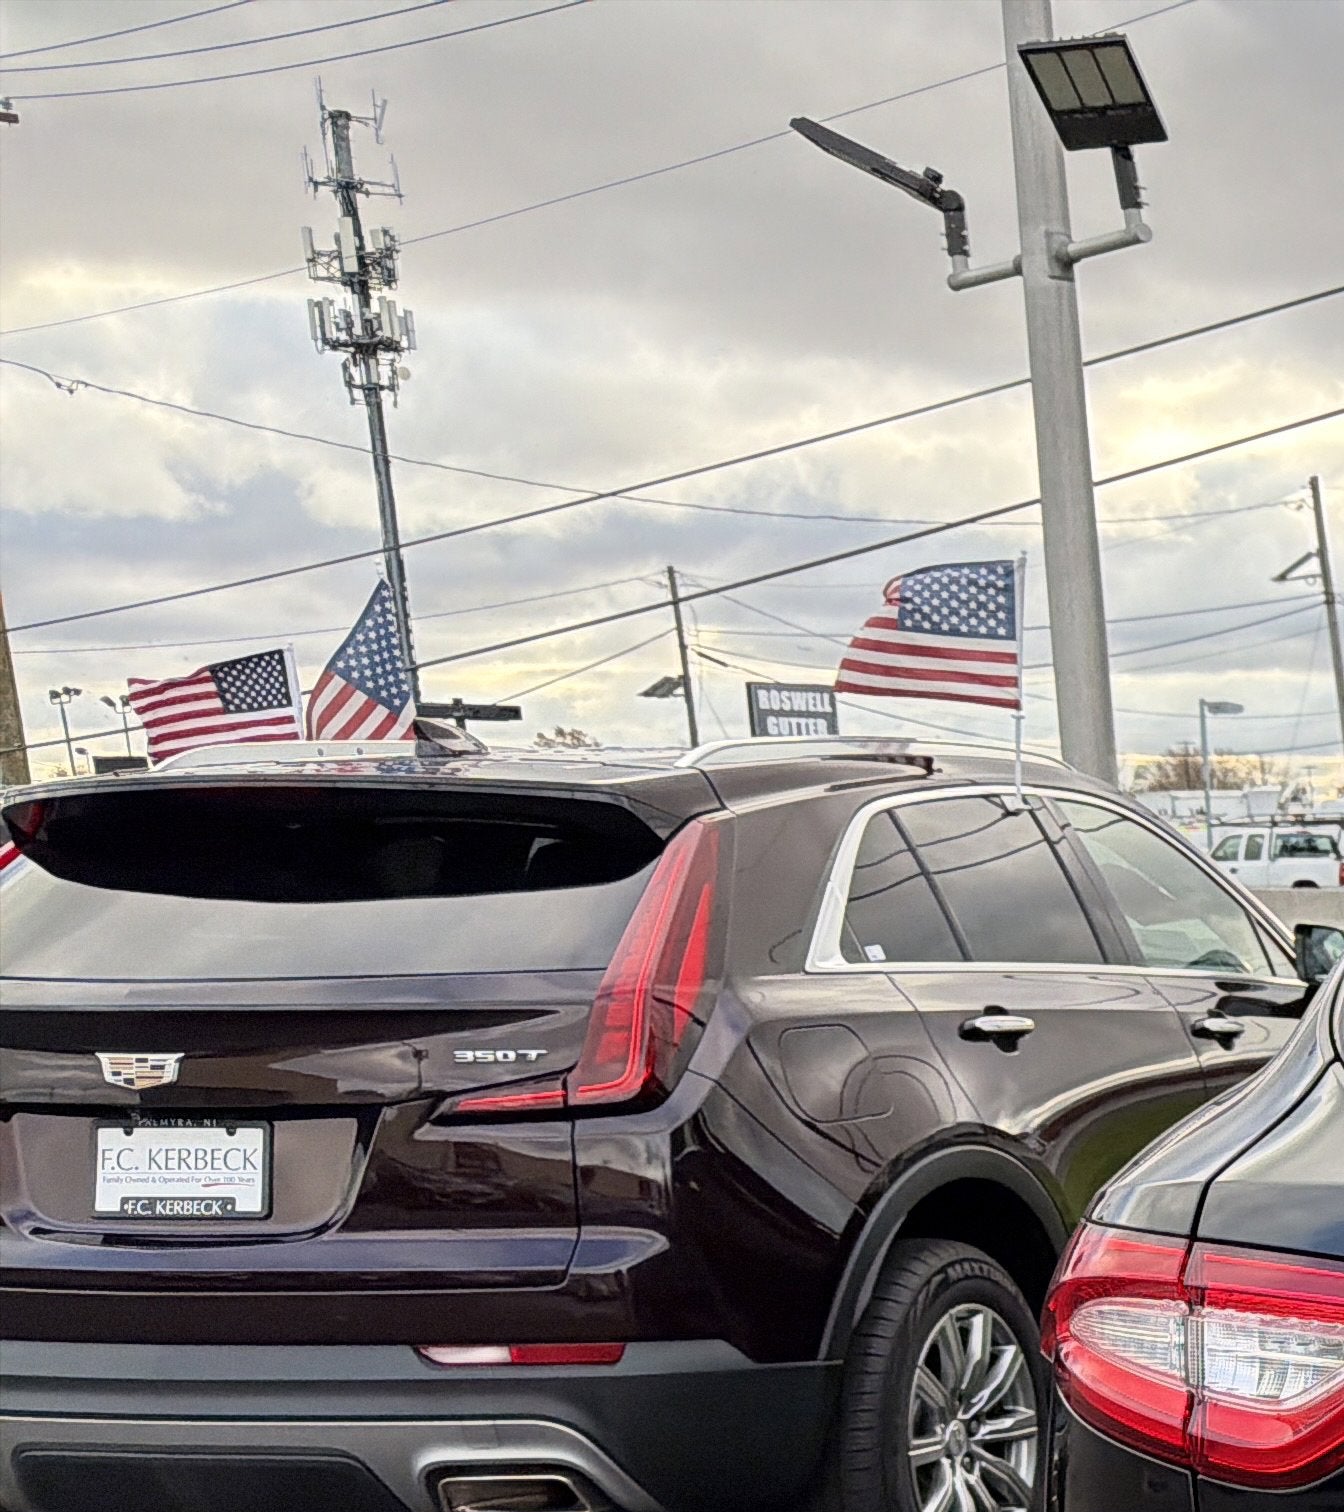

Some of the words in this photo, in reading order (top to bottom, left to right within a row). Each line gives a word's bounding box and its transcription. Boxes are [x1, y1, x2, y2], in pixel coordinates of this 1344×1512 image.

[757, 689, 833, 712] ROSWELL
[767, 716, 828, 737] GUTTER
[453, 1049, 549, 1063] 350T
[101, 1148, 139, 1171] F.C.
[148, 1147, 259, 1171] KERBECK
[103, 1175, 123, 1184] Family
[159, 1176, 190, 1184] Operated
[238, 1176, 255, 1184] Years
[155, 1200, 223, 1215] KERBECK
